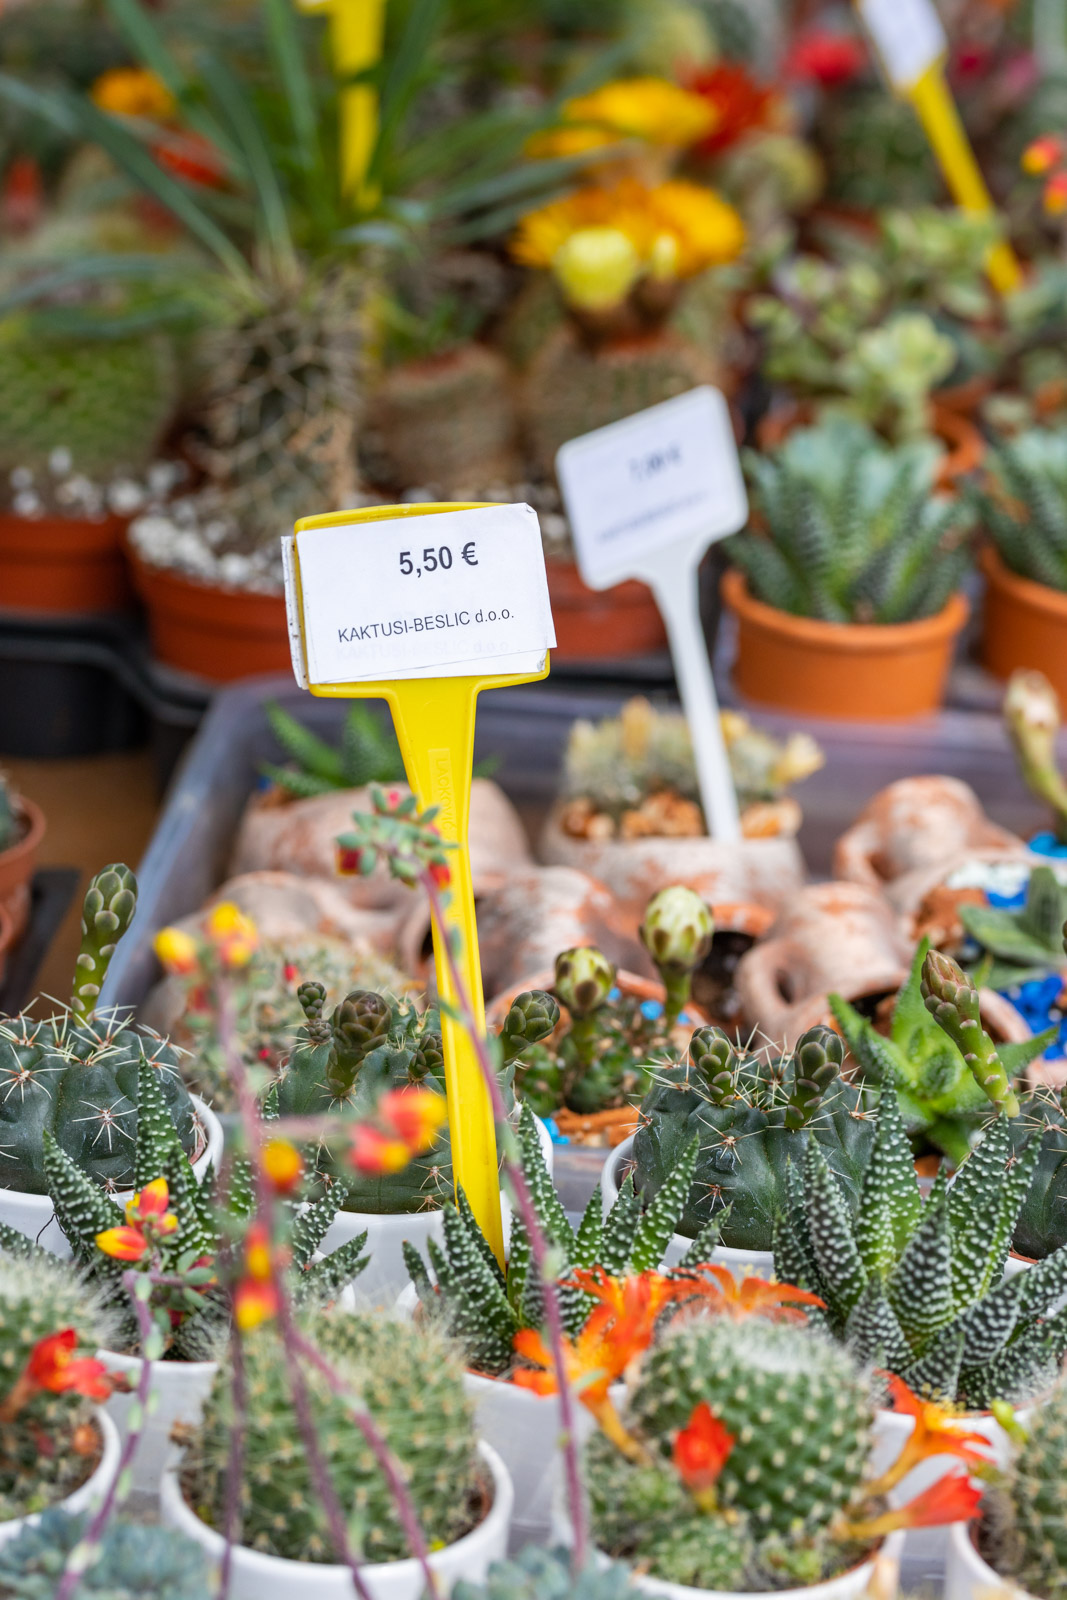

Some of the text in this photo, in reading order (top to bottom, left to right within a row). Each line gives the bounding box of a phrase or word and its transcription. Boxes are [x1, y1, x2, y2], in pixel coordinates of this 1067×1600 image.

[400, 541, 479, 578] 5,50 €
[338, 608, 514, 643] KAKTUSI-BESLIC d.o.o.
